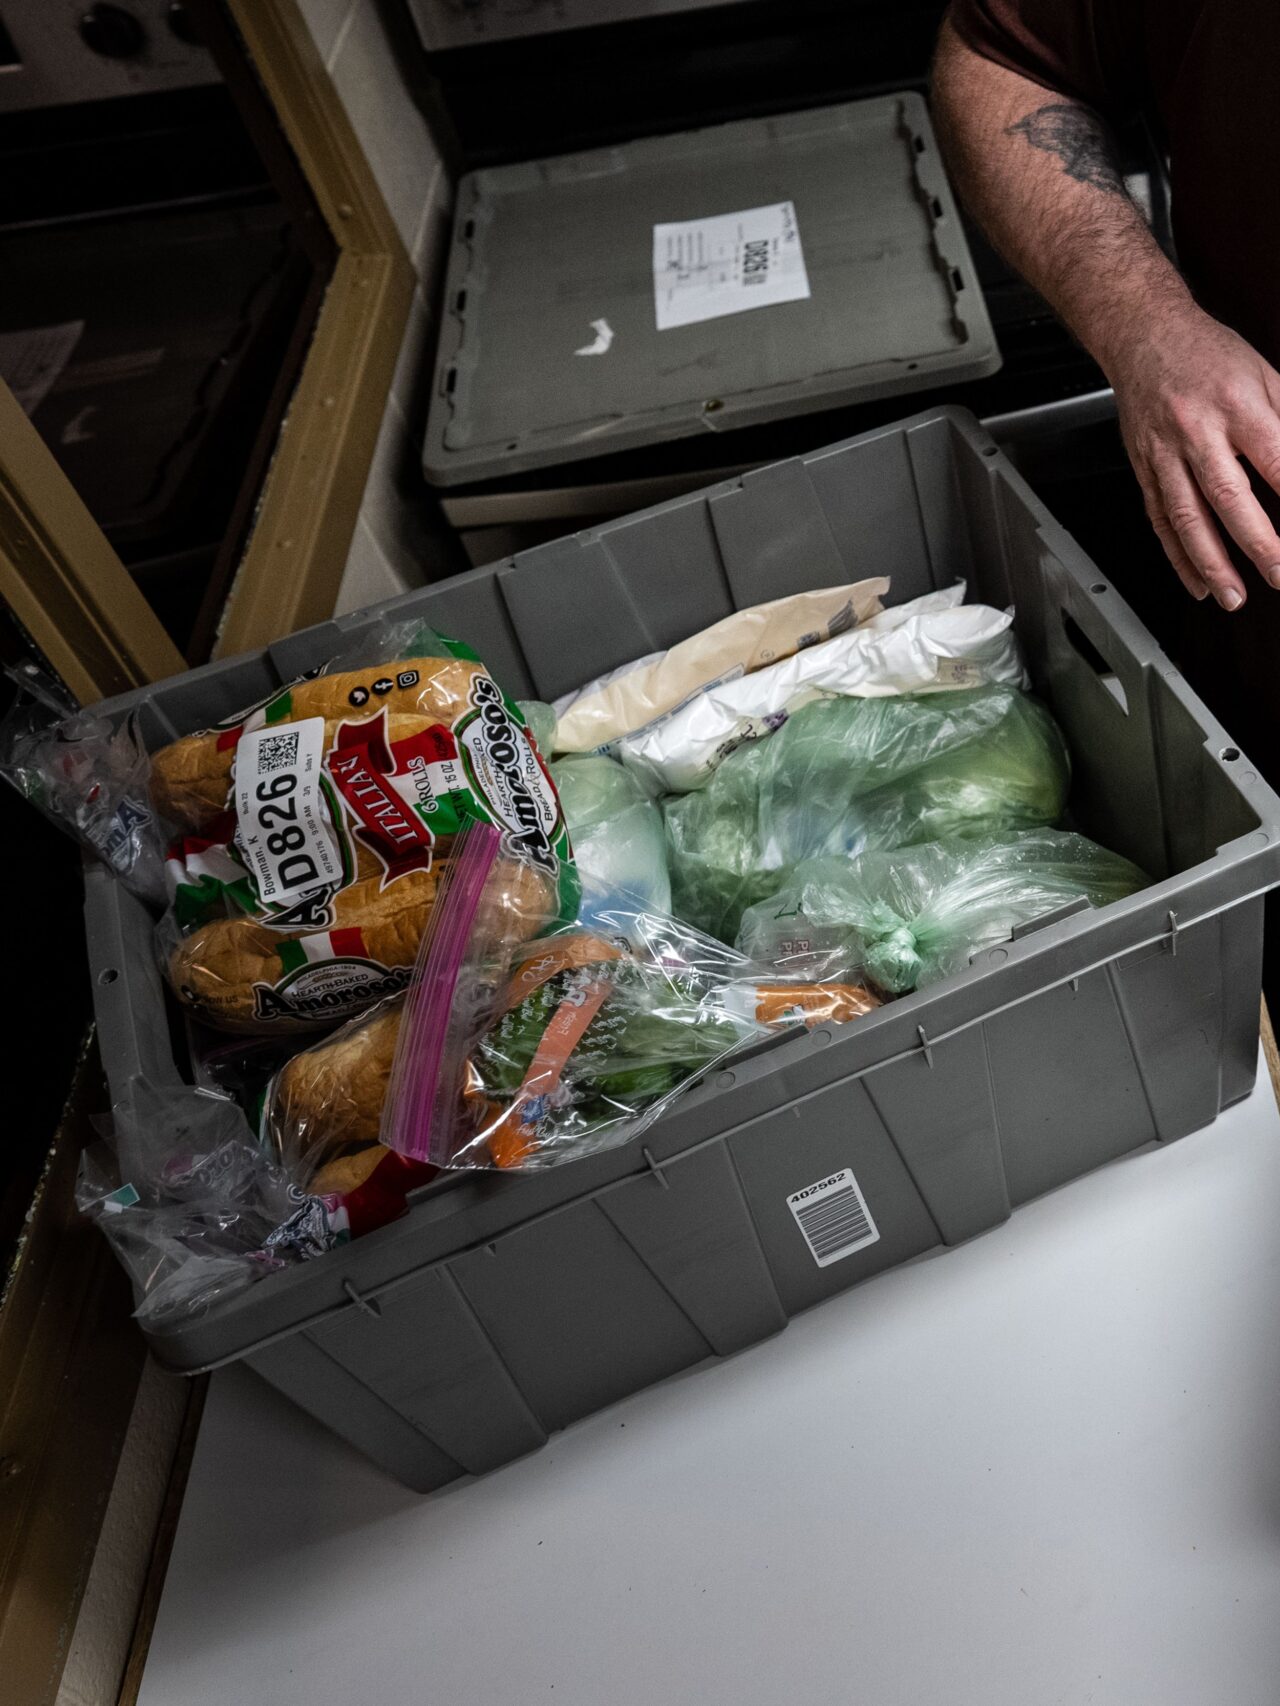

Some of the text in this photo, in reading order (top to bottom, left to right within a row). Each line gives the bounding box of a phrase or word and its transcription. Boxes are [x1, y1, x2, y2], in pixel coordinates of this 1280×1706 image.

[305, 758, 314, 773] Subs
[445, 774, 457, 784] 15
[472, 677, 559, 876] Amoroso's
[302, 785, 311, 797] 3/9
[337, 755, 420, 844] ITALIAN
[408, 757, 438, 814] 6 ROLLS
[303, 805, 315, 819] AM
[533, 786, 553, 821] BREAD
[256, 773, 320, 890] D826
[306, 819, 319, 837] 9:00
[247, 835, 277, 896] Bowman, K
[315, 840, 334, 875] 49740176
[291, 974, 369, 998] HEARTH-BAKED
[791, 1172, 846, 1203] 402562
